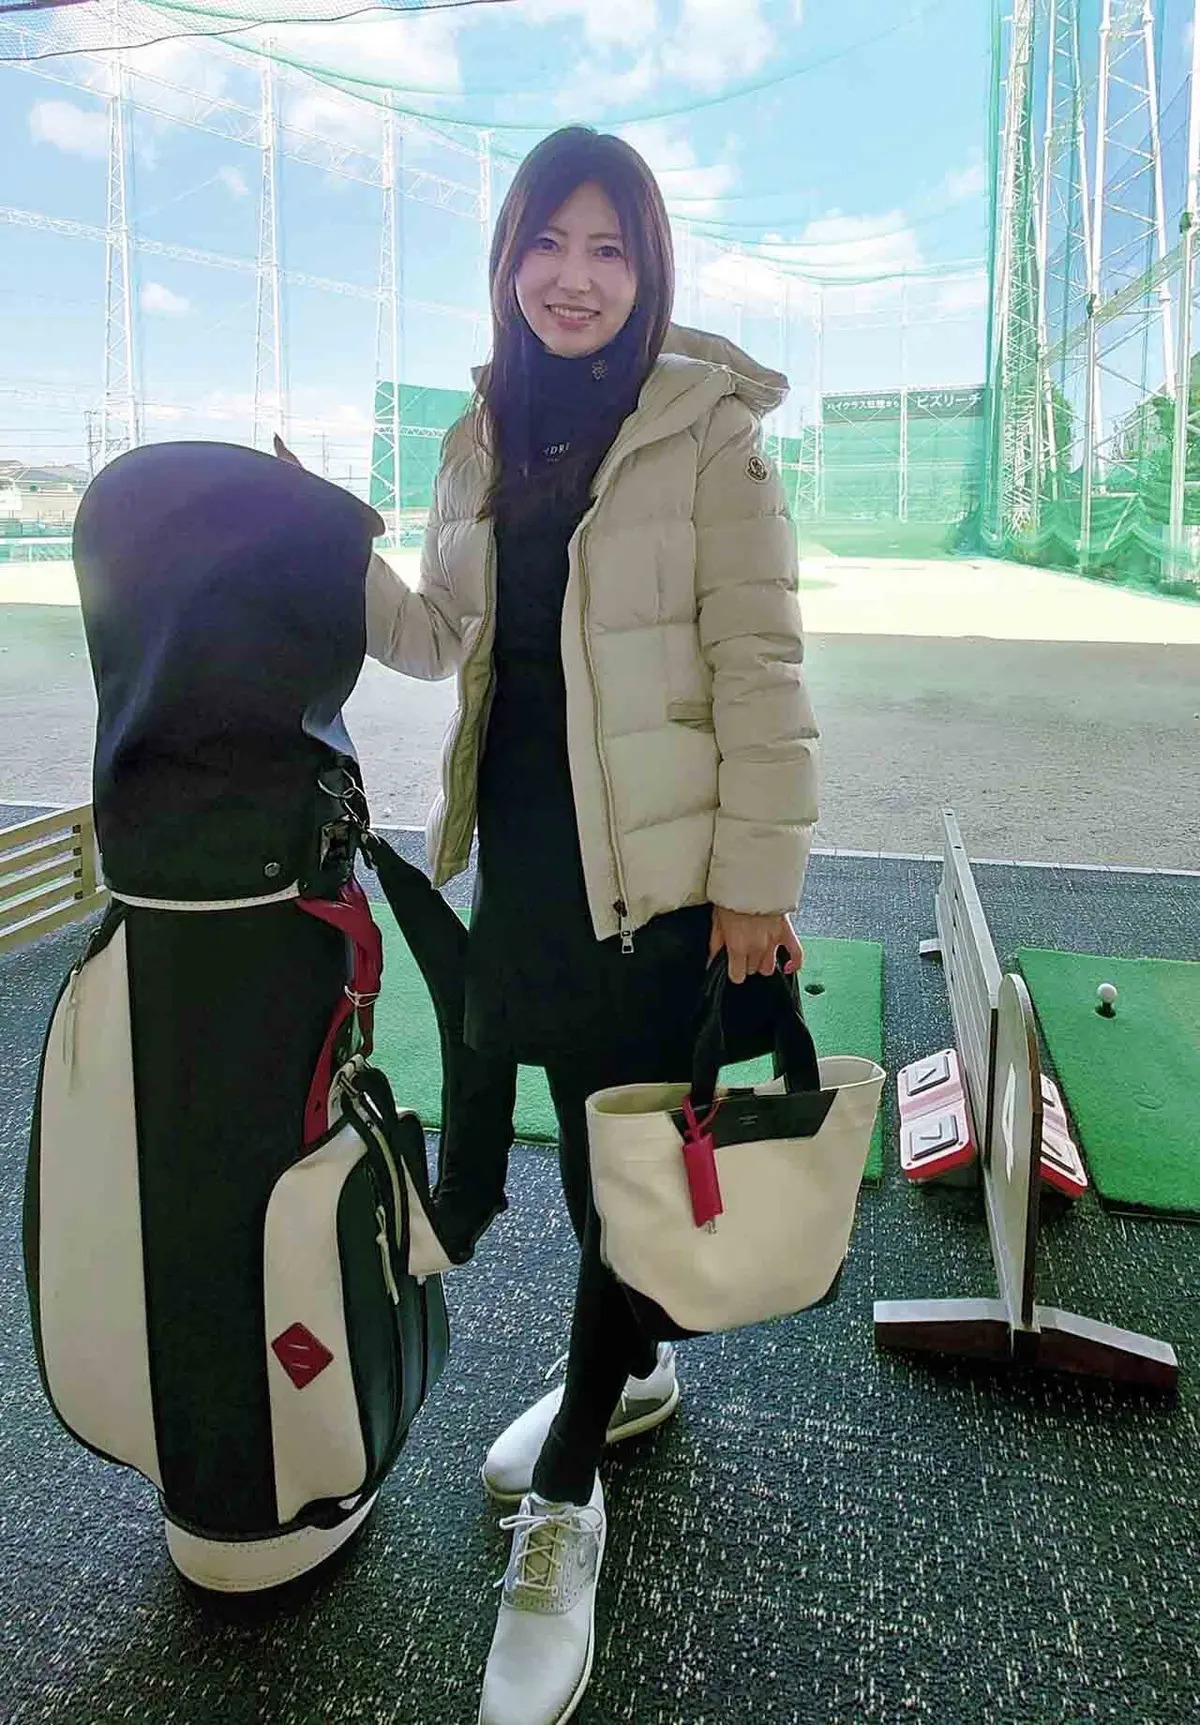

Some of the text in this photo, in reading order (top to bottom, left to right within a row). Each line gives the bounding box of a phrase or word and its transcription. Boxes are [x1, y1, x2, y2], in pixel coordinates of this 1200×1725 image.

[916, 392, 982, 408] ビズリーチ
